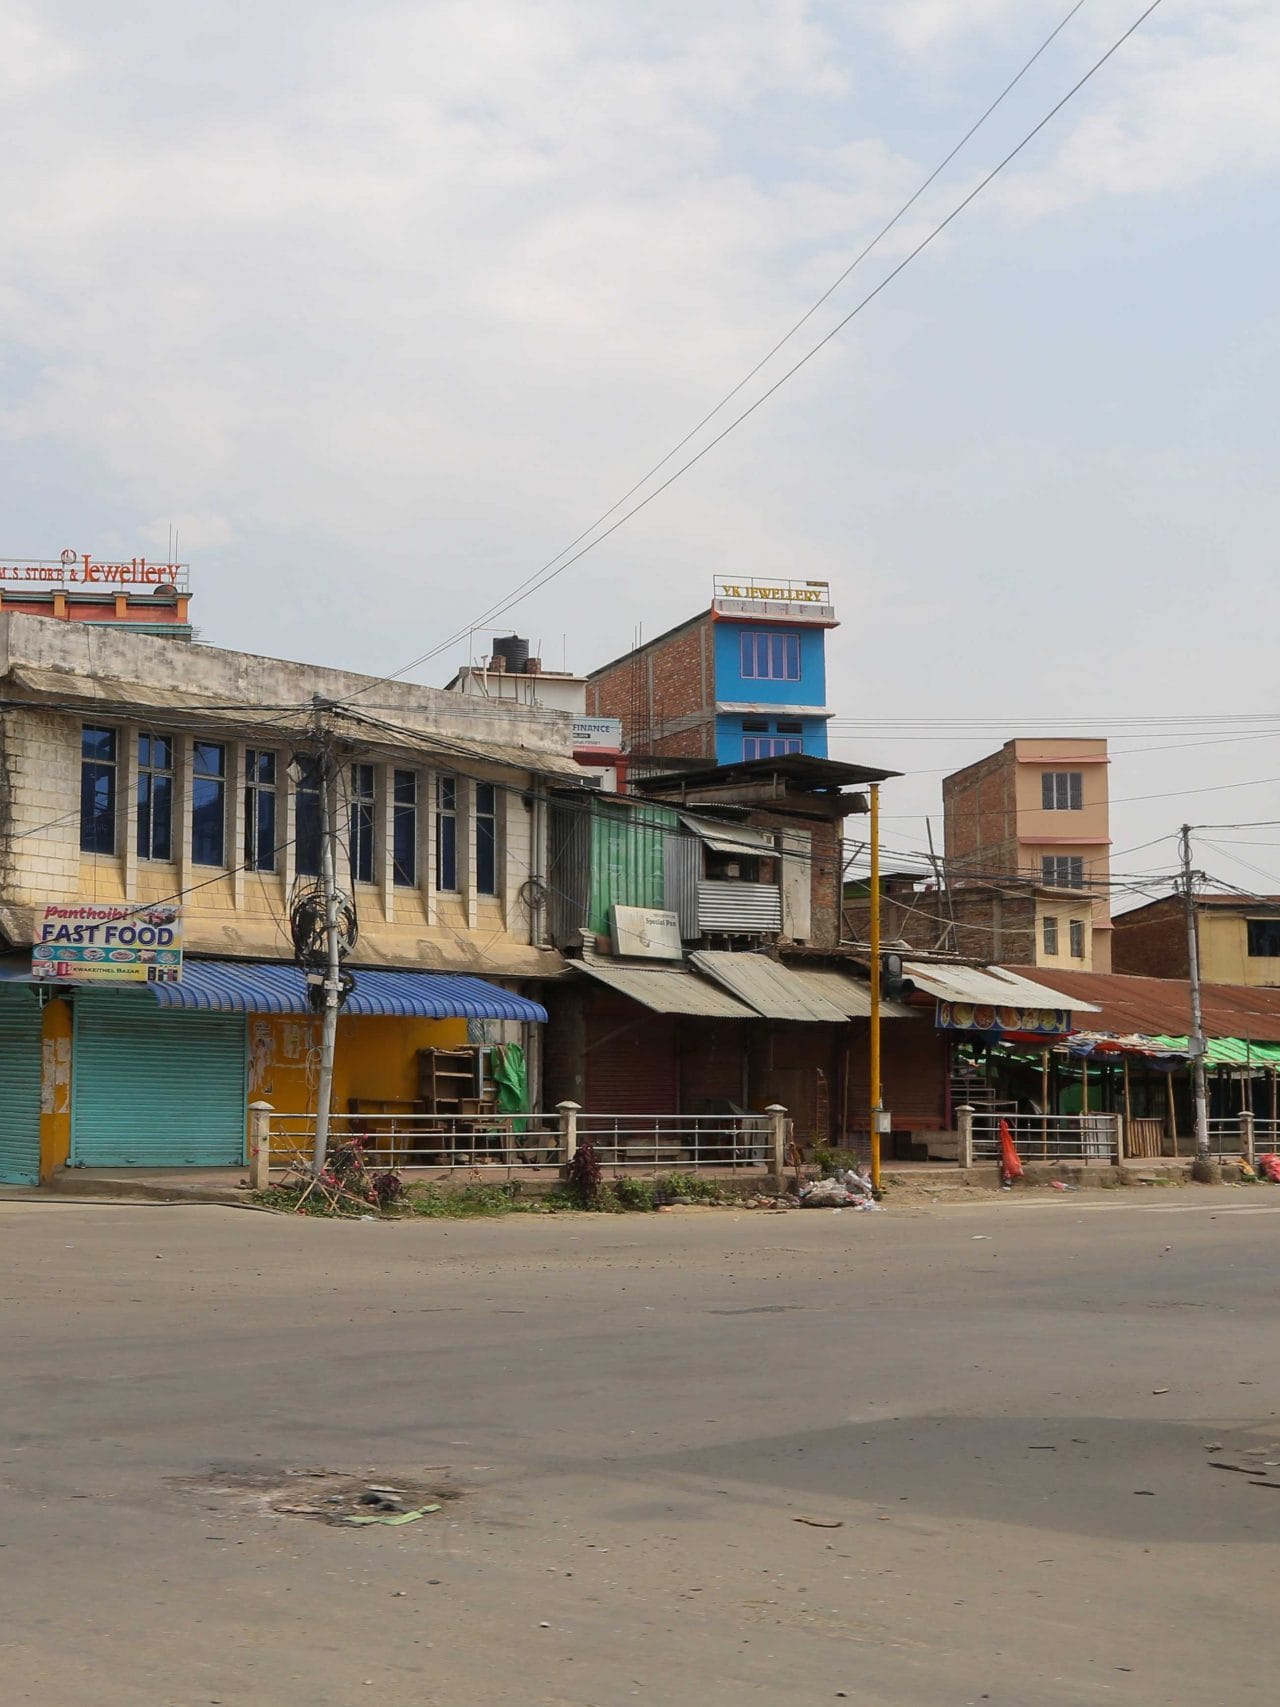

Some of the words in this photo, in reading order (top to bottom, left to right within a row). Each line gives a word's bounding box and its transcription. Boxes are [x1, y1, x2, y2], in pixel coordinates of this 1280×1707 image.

[24, 567, 64, 582] STORE
[69, 569, 79, 582] &
[81, 554, 181, 585] Jewellery
[722, 585, 741, 598] YK
[745, 587, 822, 601] JEWELLERY
[572, 723, 611, 733] FINANCE
[44, 905, 129, 921] Panthoibi
[645, 917, 665, 927] Special
[41, 923, 100, 944] FAST
[105, 925, 174, 947] FOOD
